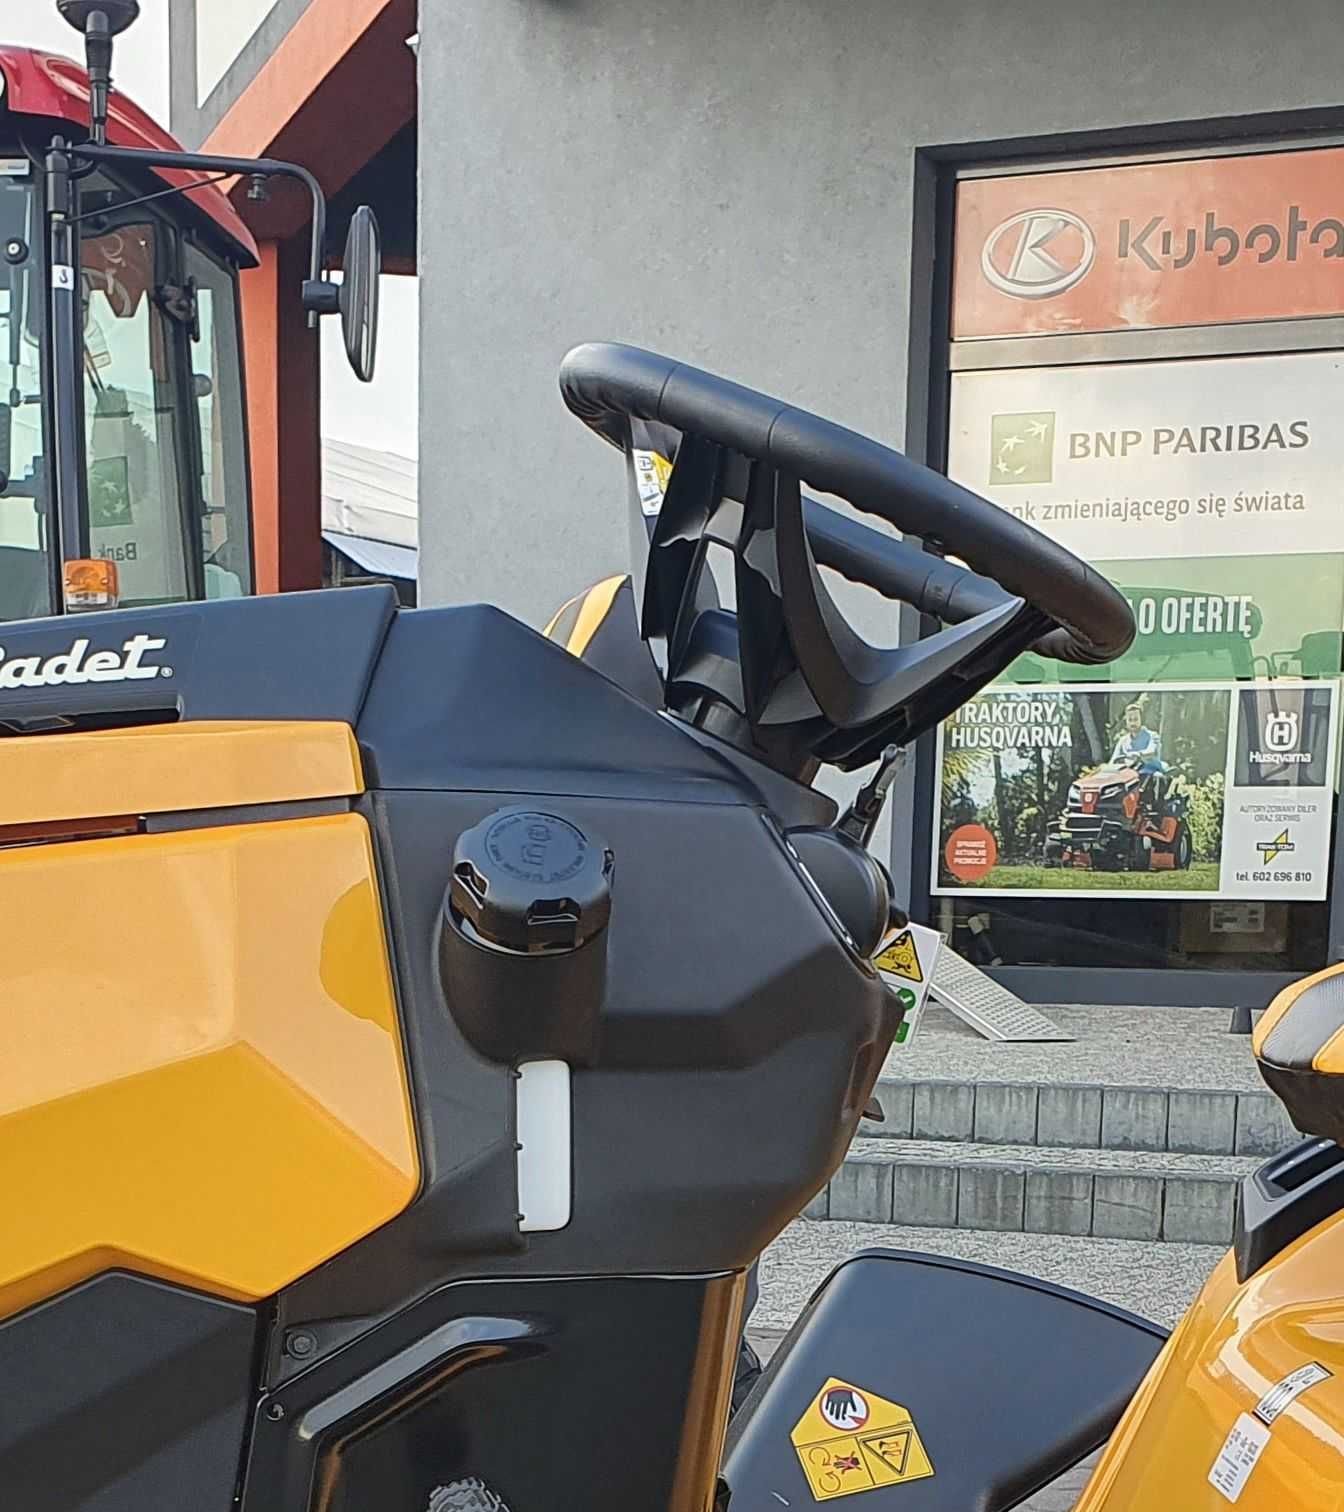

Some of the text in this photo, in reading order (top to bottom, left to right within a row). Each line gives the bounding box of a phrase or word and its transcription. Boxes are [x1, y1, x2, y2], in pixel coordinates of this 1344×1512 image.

[1069, 421, 1309, 459] BNP PARIBAS
[1042, 498, 1189, 522] zmieniającego
[1197, 493, 1226, 518] się
[1233, 490, 1305, 513] świata
[1140, 596, 1252, 638] O OFERTĘ
[955, 702, 1056, 725] TRAKTORY
[951, 726, 1072, 748] HUSQVARNA
[1249, 751, 1311, 765] Husqvarna
[1253, 872, 1271, 881] 602
[1273, 872, 1292, 881] 696
[1295, 872, 1311, 881] 810
